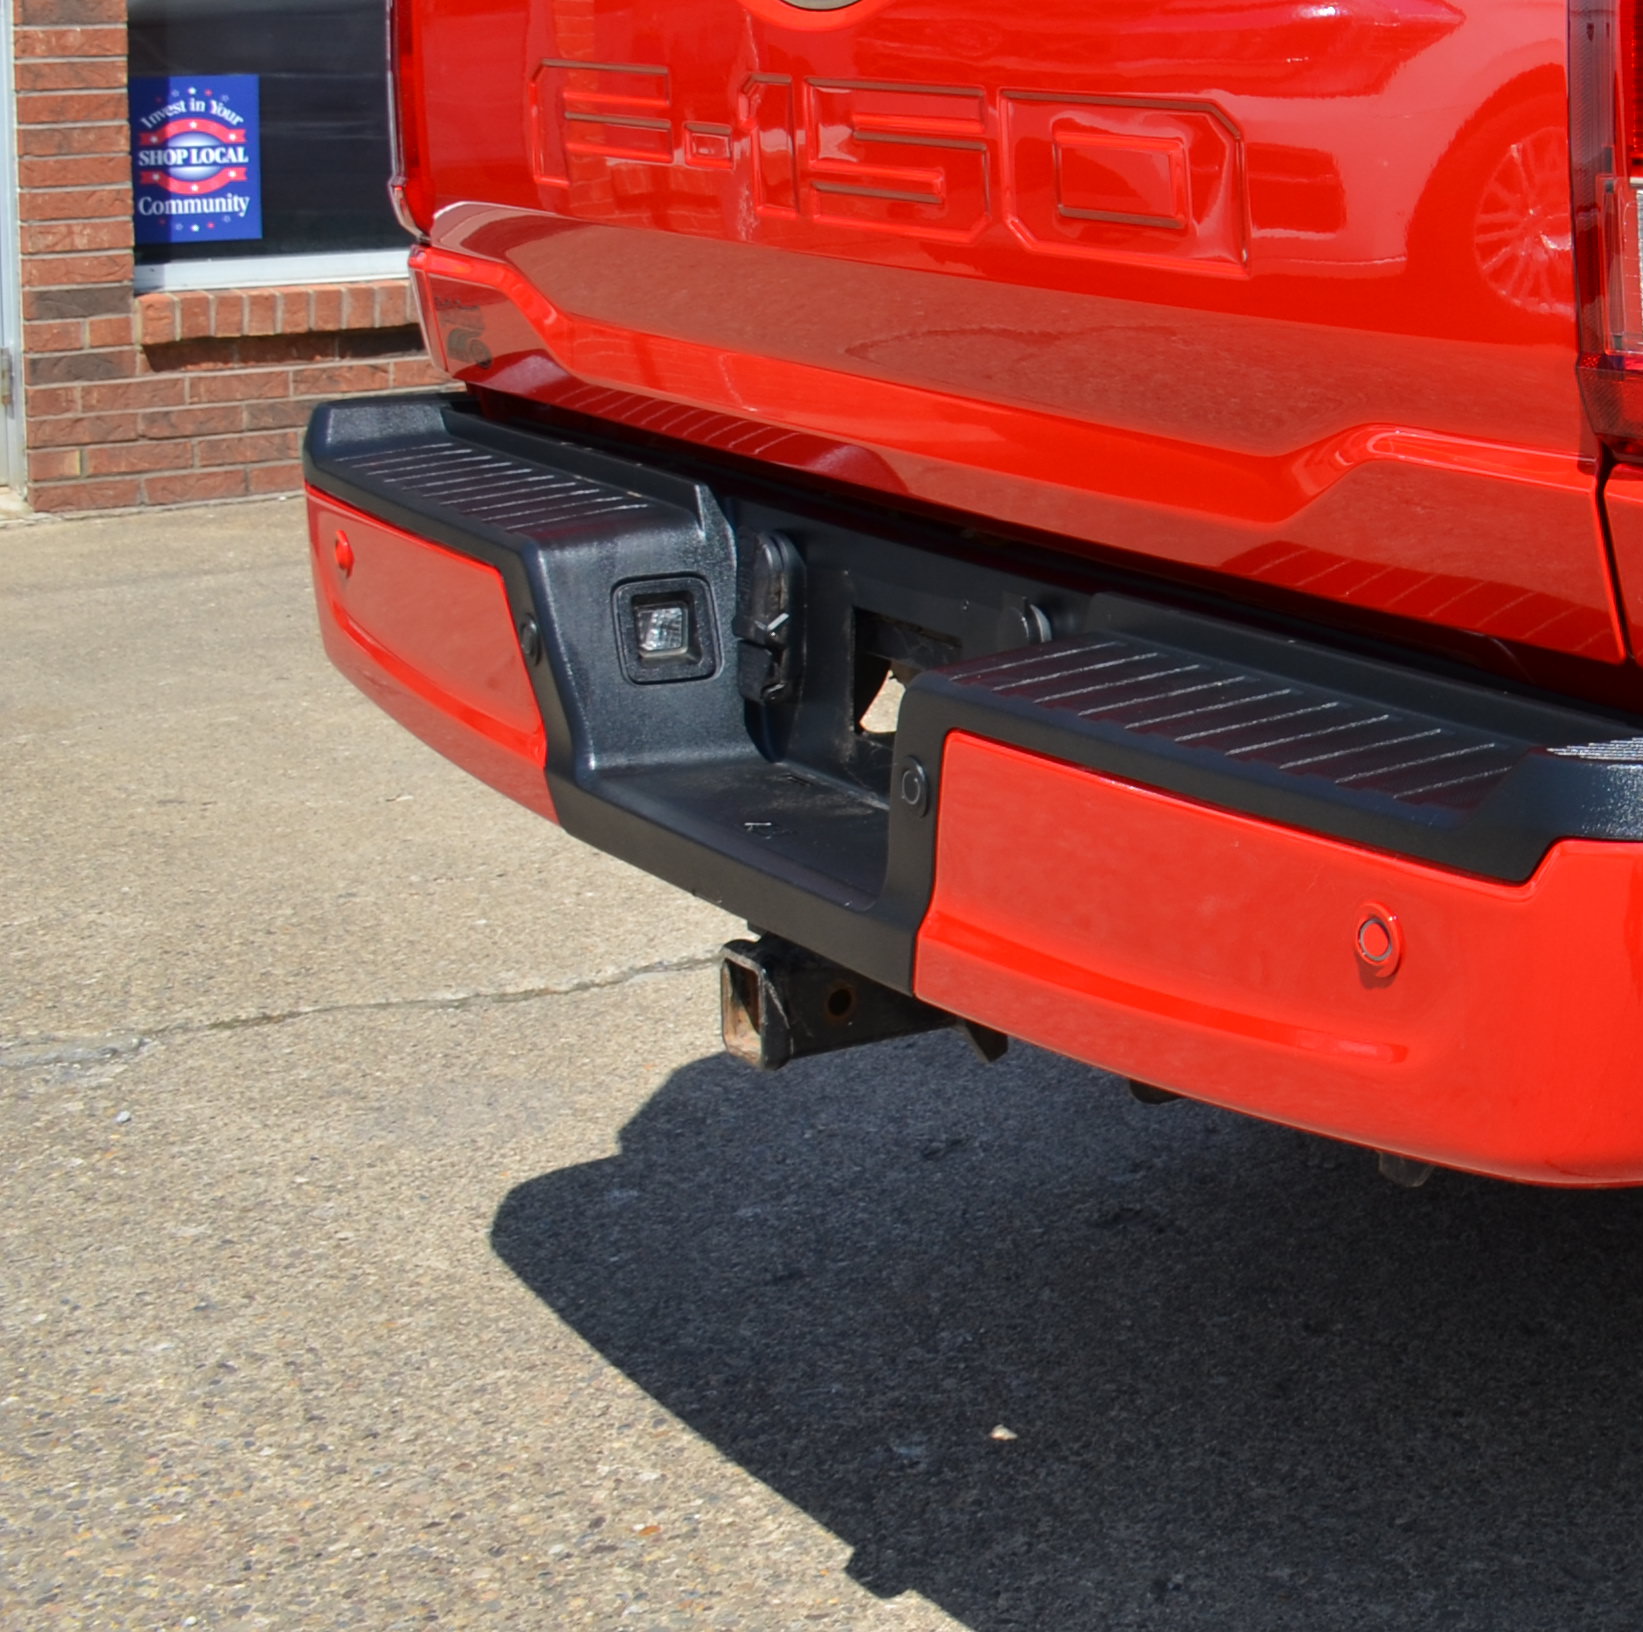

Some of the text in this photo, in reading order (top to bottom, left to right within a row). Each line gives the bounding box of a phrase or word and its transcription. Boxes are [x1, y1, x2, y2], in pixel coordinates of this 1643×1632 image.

[141, 97, 244, 129] Invest in Your
[138, 146, 249, 167] SHOP LOCAL
[530, 57, 1250, 278] F-150
[138, 192, 250, 218] Community
